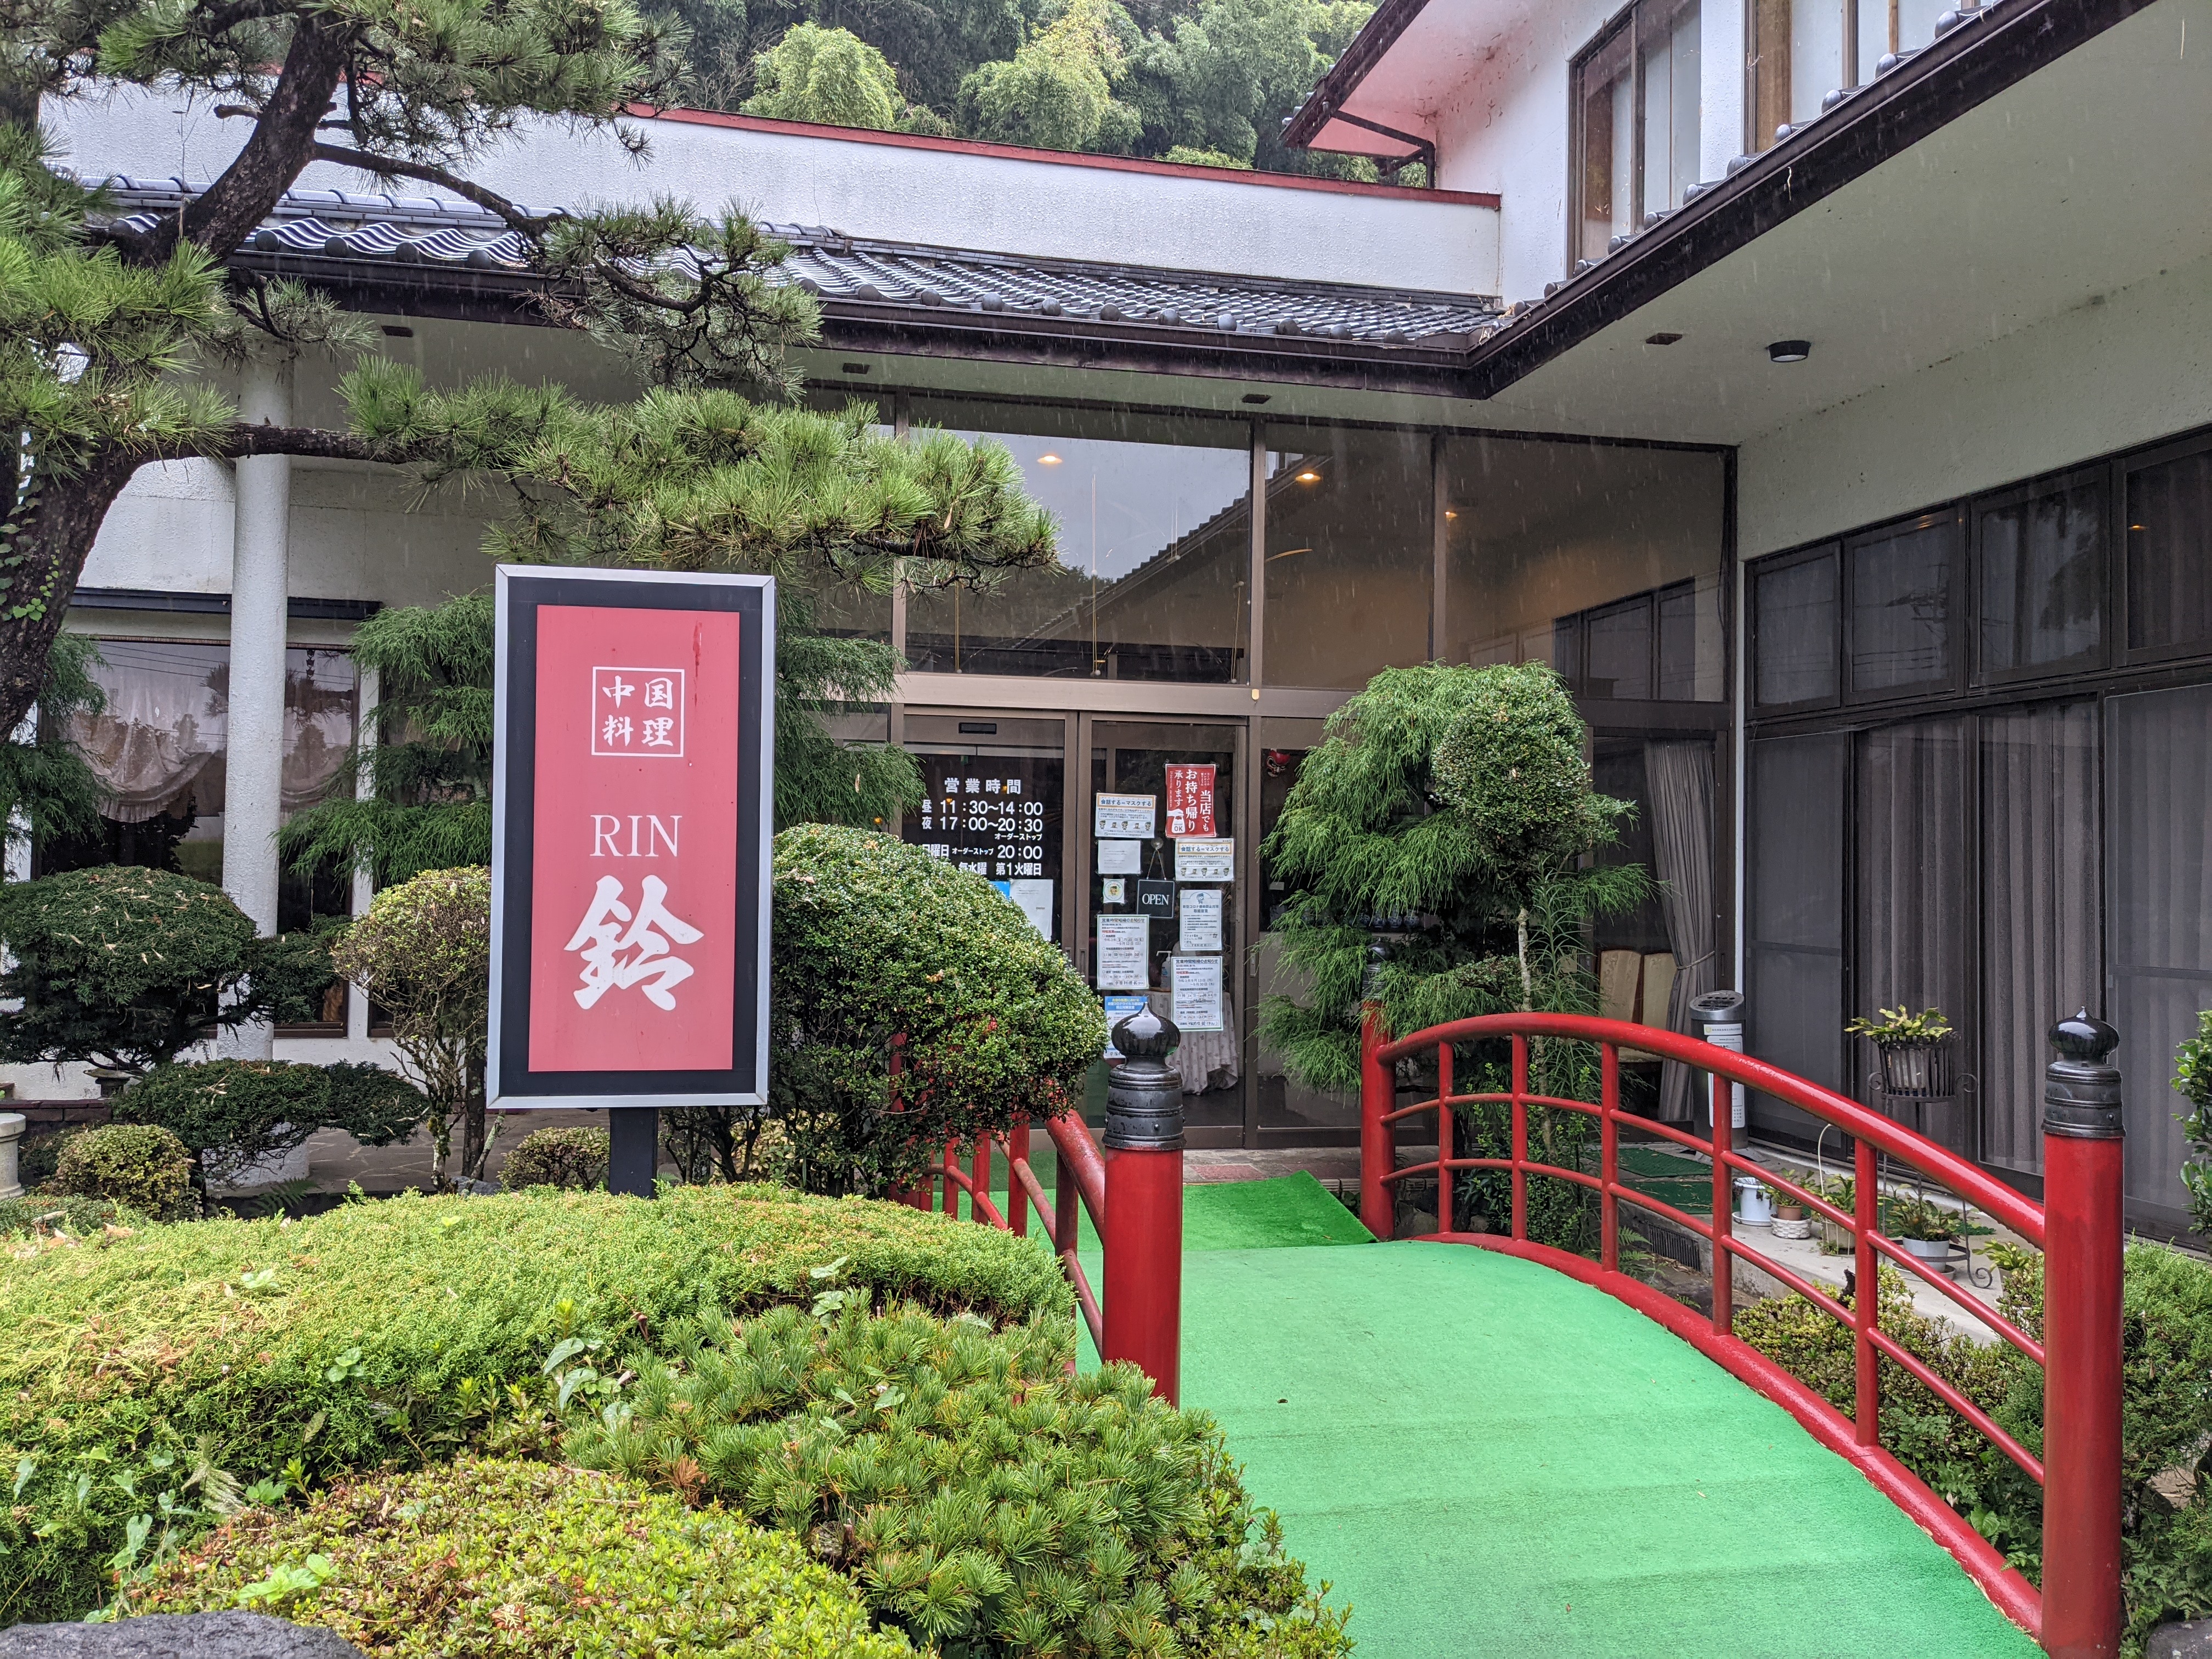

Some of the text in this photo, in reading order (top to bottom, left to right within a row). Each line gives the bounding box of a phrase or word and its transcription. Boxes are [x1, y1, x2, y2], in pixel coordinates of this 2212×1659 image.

[601, 675, 673, 711] 中国
[602, 715, 674, 747] 料理
[945, 777, 1021, 794] 営業時間
[1174, 770, 1183, 807] 承ります
[1185, 769, 1198, 832] お持ち帰り
[922, 799, 932, 813] 昼
[1200, 790, 1211, 831] 当店でも
[590, 814, 682, 858] RIN
[922, 816, 932, 830] 夜
[952, 847, 994, 855] オーダーストップ
[997, 845, 1042, 859] 20:00
[996, 862, 1041, 876] 第1火曜日
[1142, 893, 1169, 905] OPEN
[563, 874, 704, 1011] 鈴
